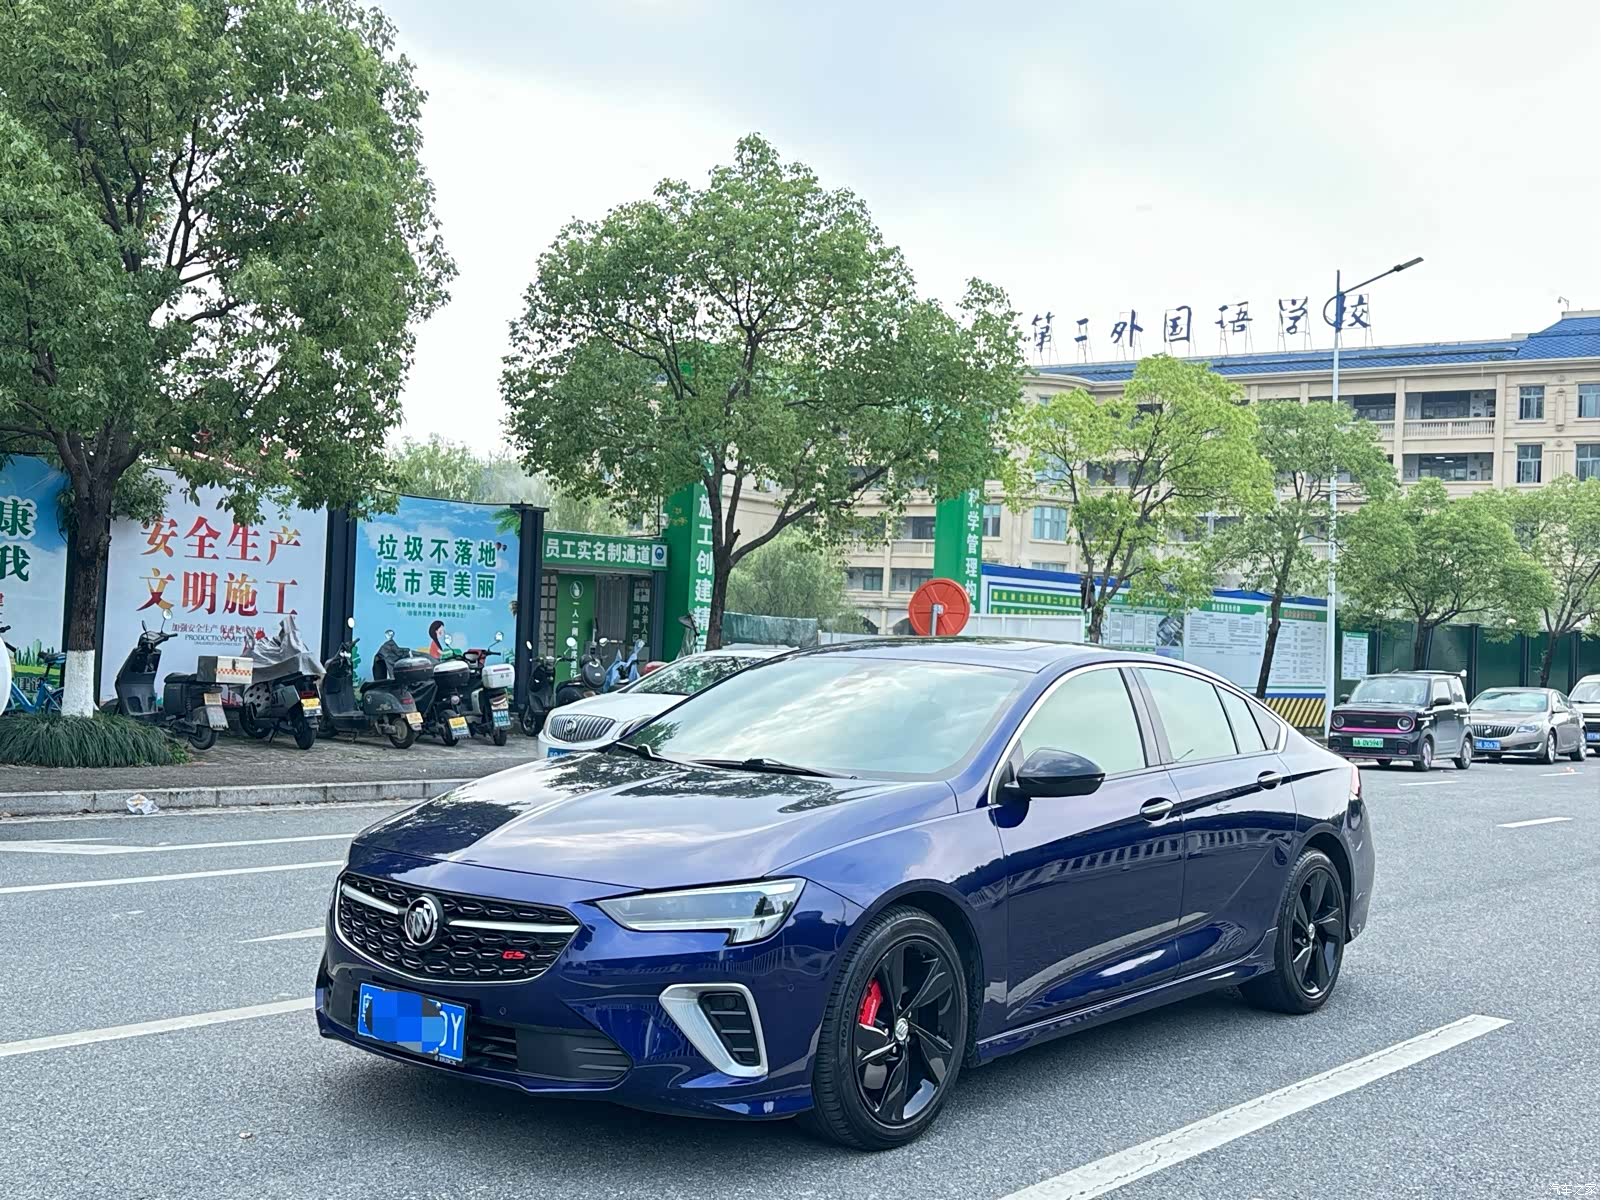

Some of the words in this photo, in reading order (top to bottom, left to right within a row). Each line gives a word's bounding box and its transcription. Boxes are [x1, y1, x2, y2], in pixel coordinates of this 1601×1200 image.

[1032, 293, 1371, 350] 第二外国语学校
[0, 498, 34, 536] 康
[140, 516, 302, 565] 安全生产
[377, 534, 497, 567] 垃圾不落地
[546, 538, 651, 564] 员工实名制通道
[0, 545, 31, 581] 我
[136, 568, 298, 617] 文明施工
[375, 567, 496, 599] 城市更美丽
[503, 950, 526, 960] GS
